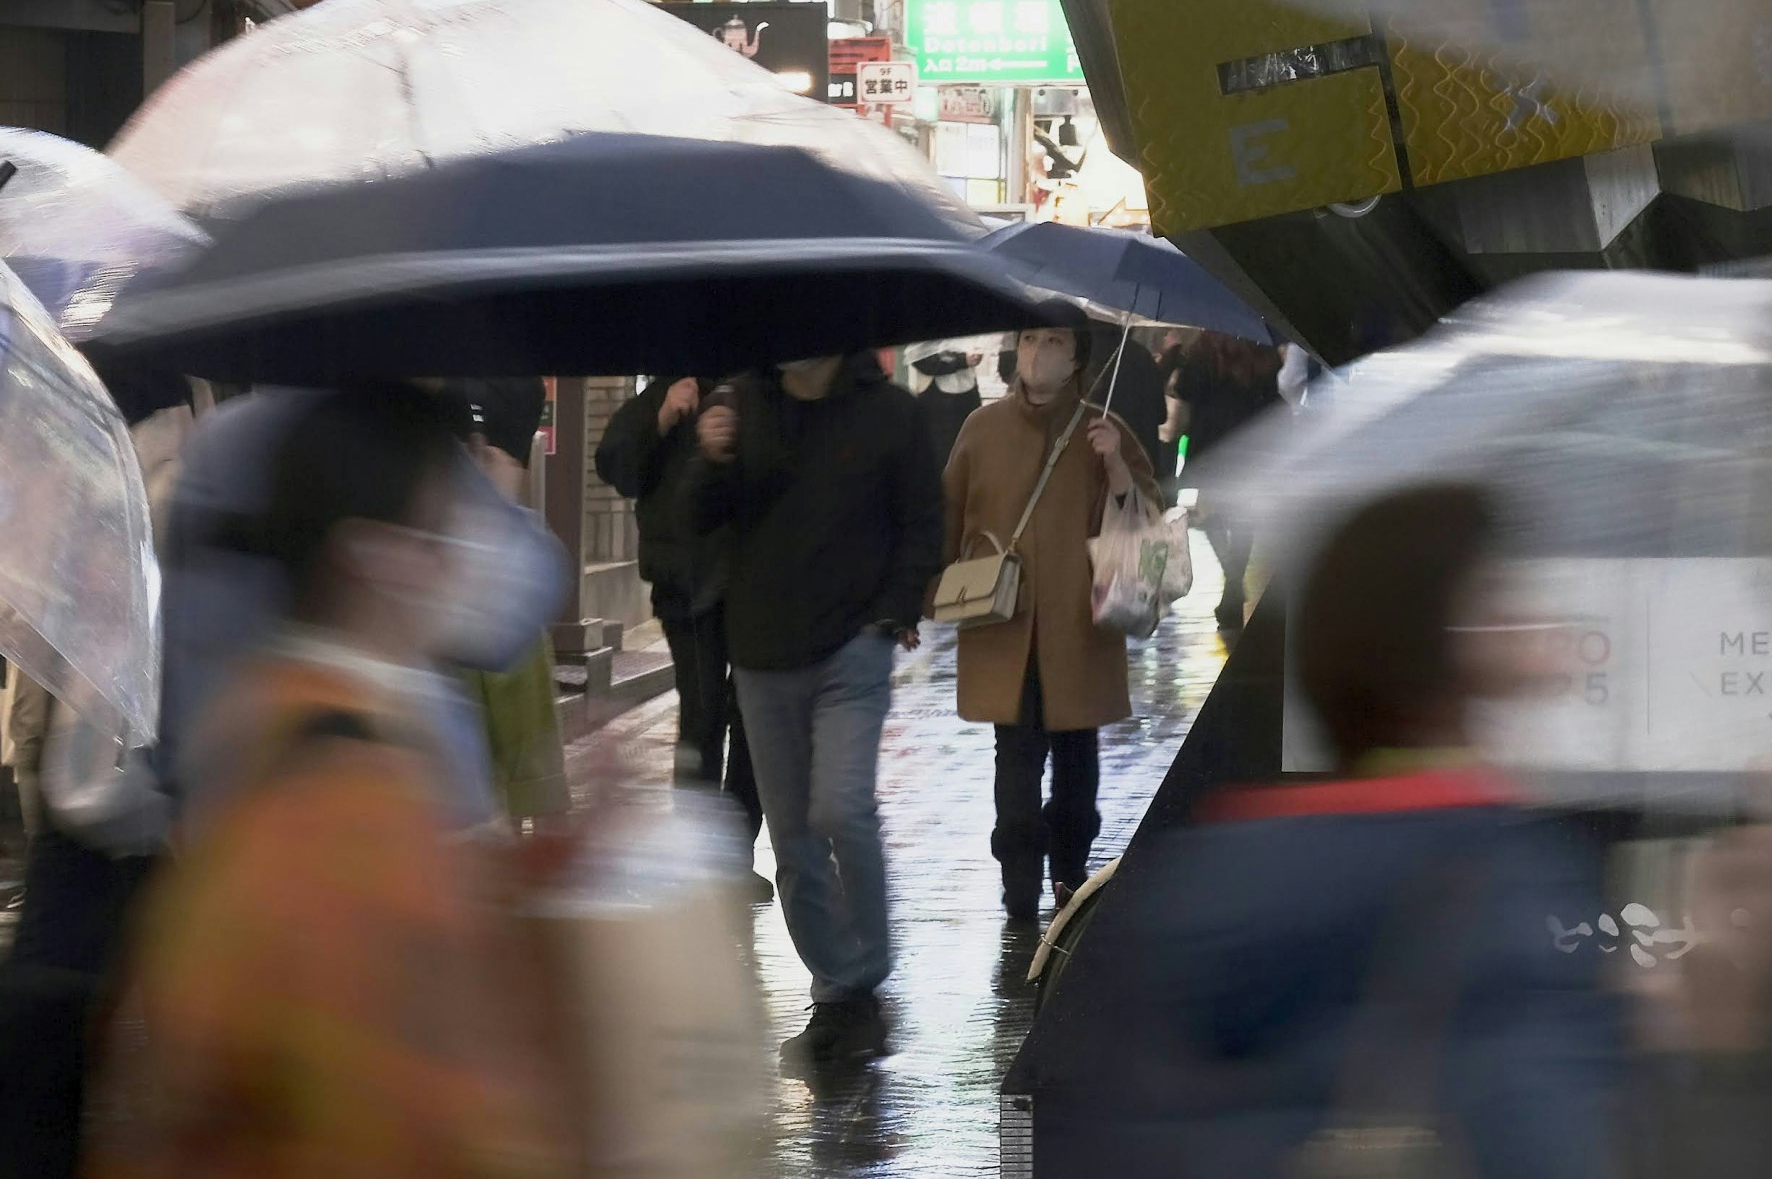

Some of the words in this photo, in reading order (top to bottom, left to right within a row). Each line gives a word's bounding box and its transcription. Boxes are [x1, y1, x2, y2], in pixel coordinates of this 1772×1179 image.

[865, 79, 908, 94] 営業中
[1229, 118, 1297, 190] E
